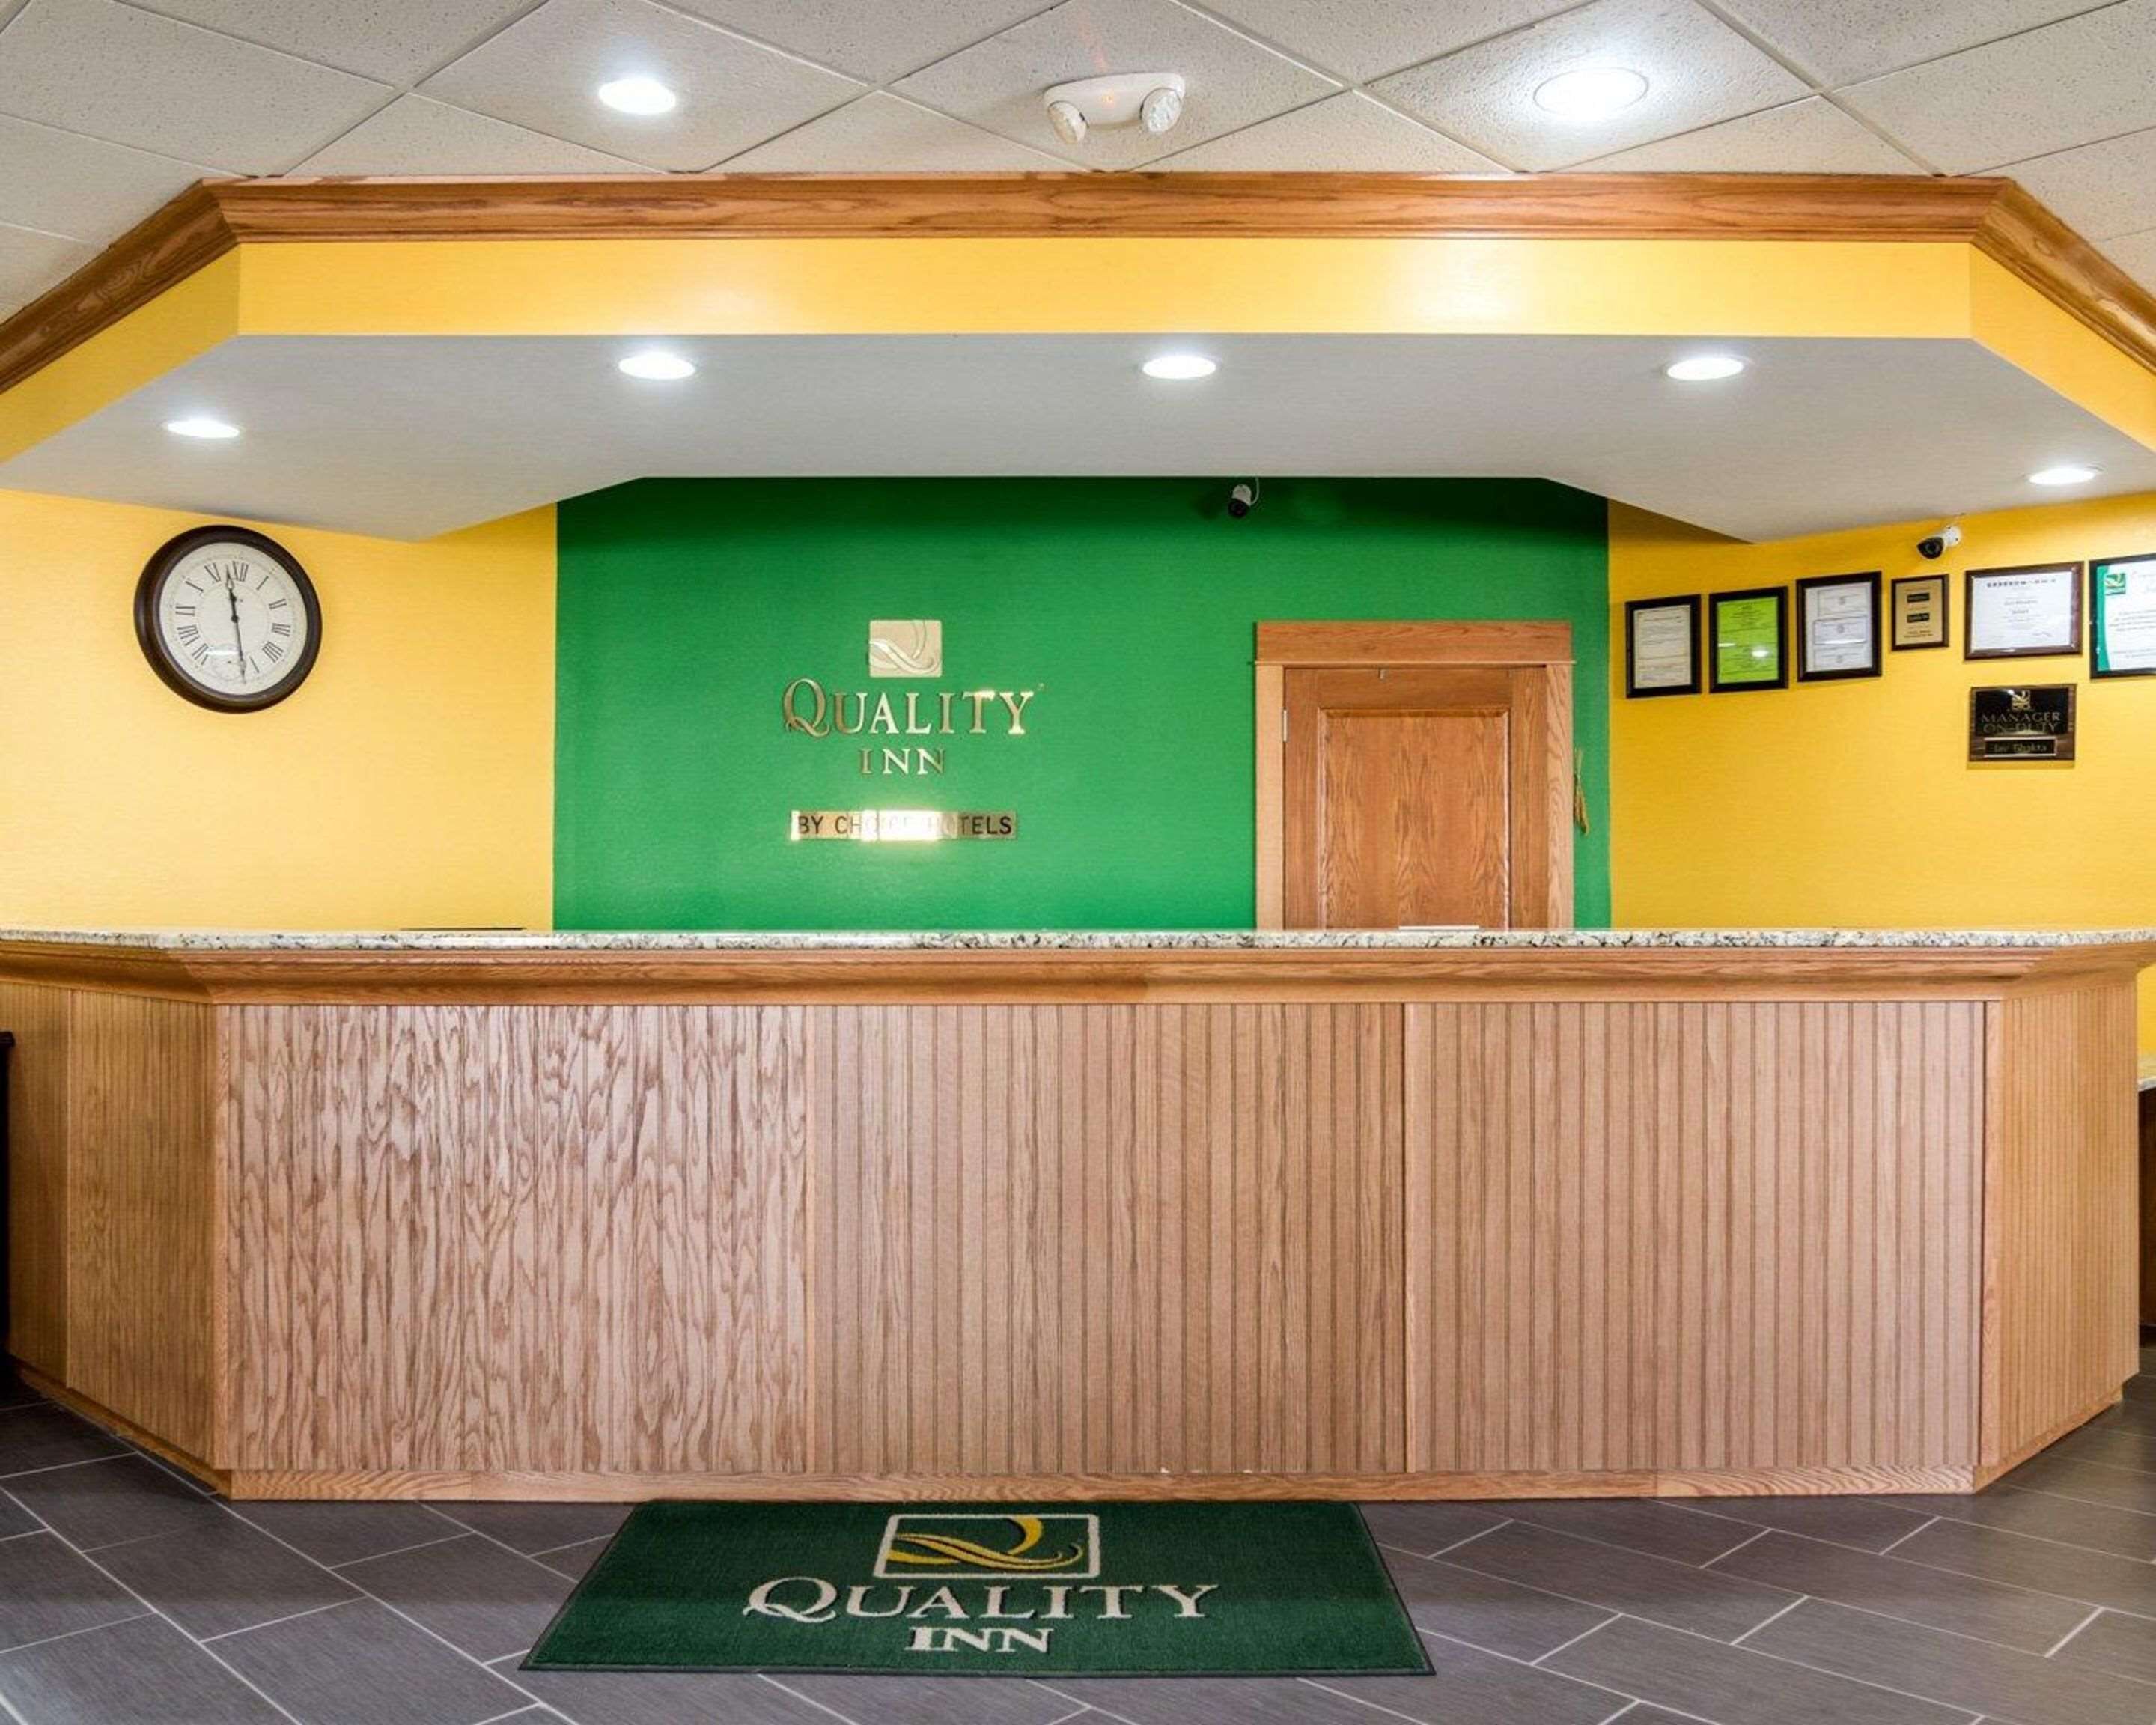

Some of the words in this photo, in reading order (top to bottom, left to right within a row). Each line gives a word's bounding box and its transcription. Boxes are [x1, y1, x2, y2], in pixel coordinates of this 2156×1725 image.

[783, 678, 1035, 737] QUALITY
[1981, 711, 2061, 724] MANAGER
[858, 748, 945, 775] INN
[798, 815, 824, 835] BY
[928, 815, 1012, 835] OTELS
[743, 1577, 1219, 1623] QUALITY
[904, 1625, 1055, 1654] INN
